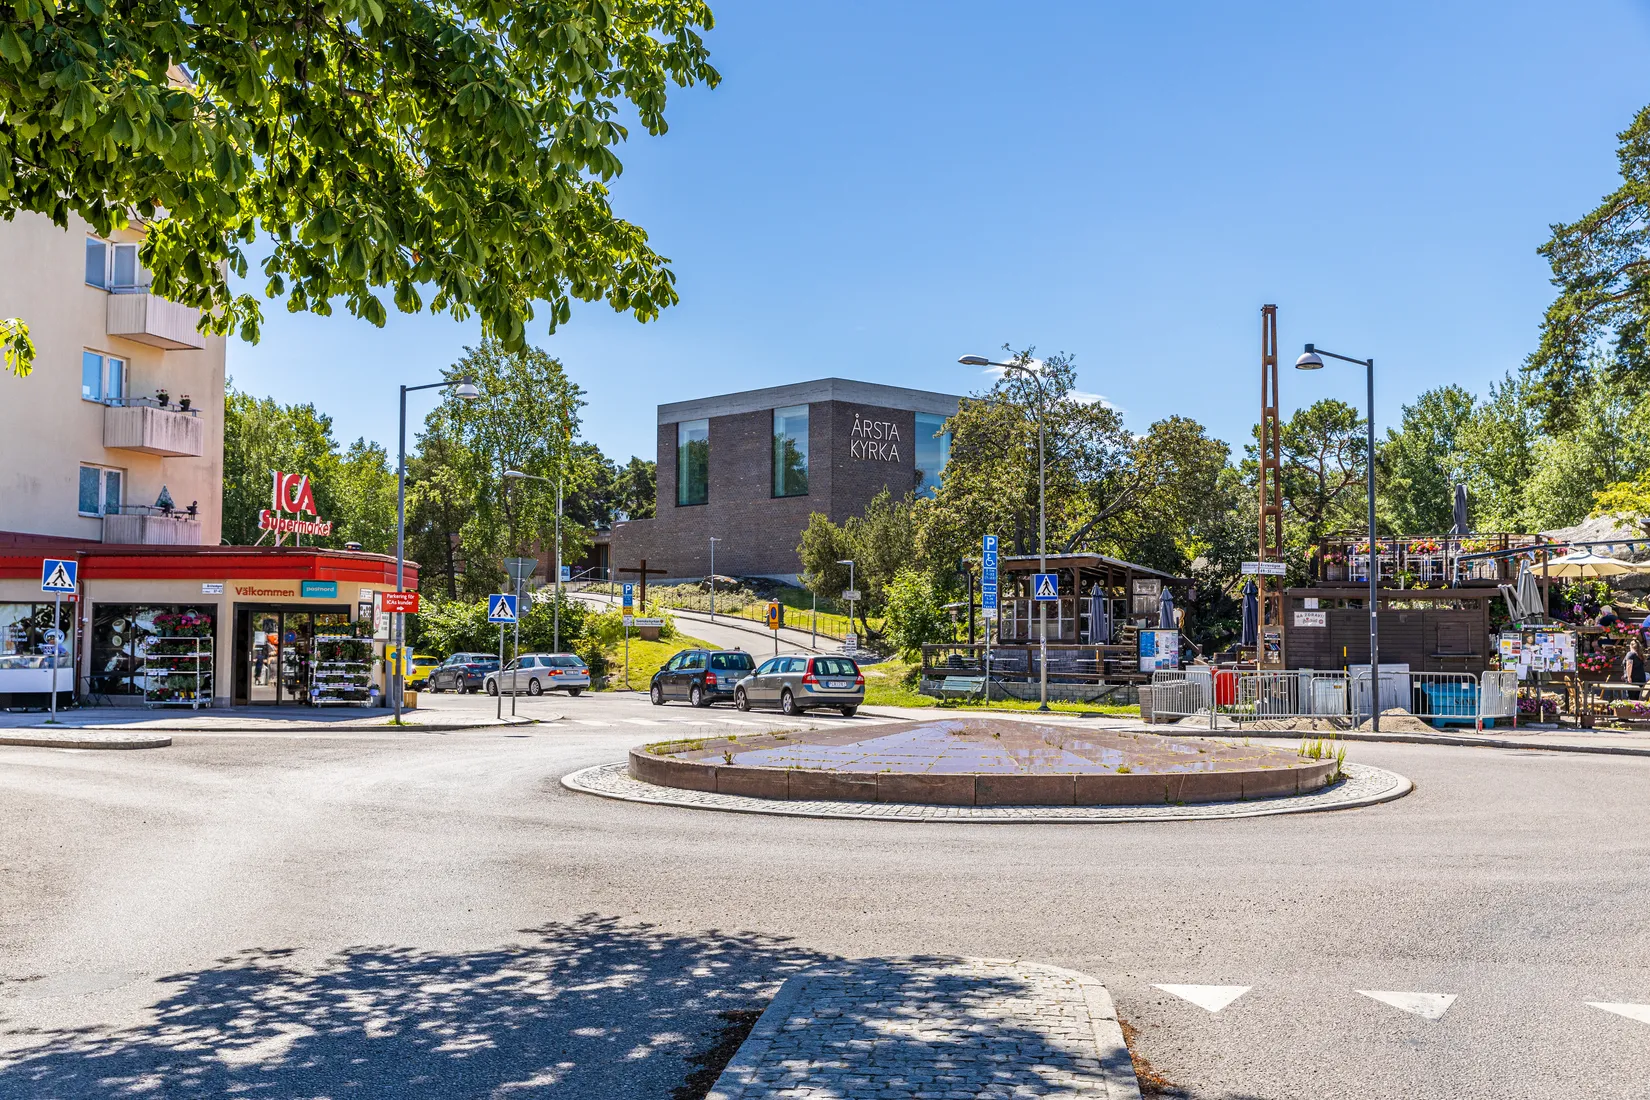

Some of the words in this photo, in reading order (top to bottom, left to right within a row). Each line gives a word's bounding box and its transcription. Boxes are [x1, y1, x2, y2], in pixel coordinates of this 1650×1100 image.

[851, 413, 900, 441] ÅRSTA
[850, 440, 900, 462] KYRKA
[273, 471, 317, 515] ICA
[258, 509, 333, 537] Supermarket
[987, 537, 995, 550] P
[235, 586, 295, 597] Välkommen
